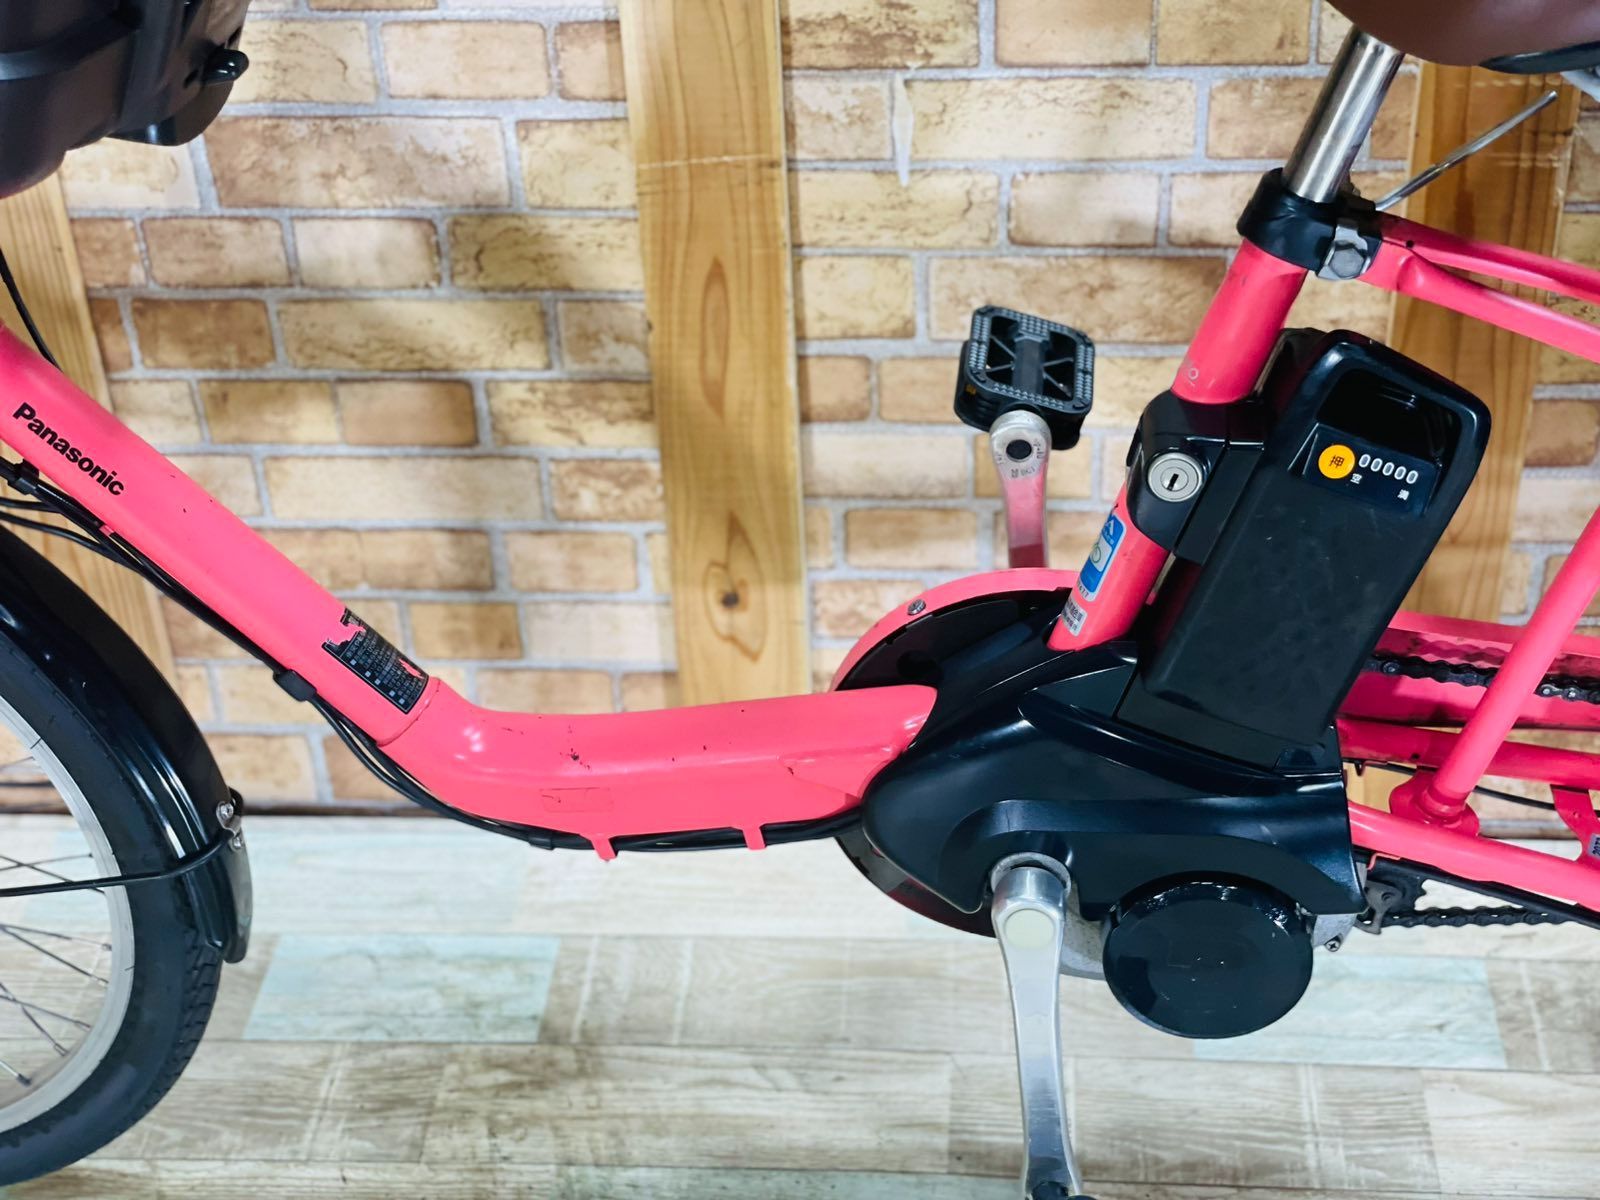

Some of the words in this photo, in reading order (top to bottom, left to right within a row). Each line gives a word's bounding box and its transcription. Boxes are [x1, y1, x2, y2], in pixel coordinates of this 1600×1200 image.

[13, 402, 124, 495] Panasonic
[1329, 455, 1344, 468] 押
[1350, 473, 1362, 484] 空
